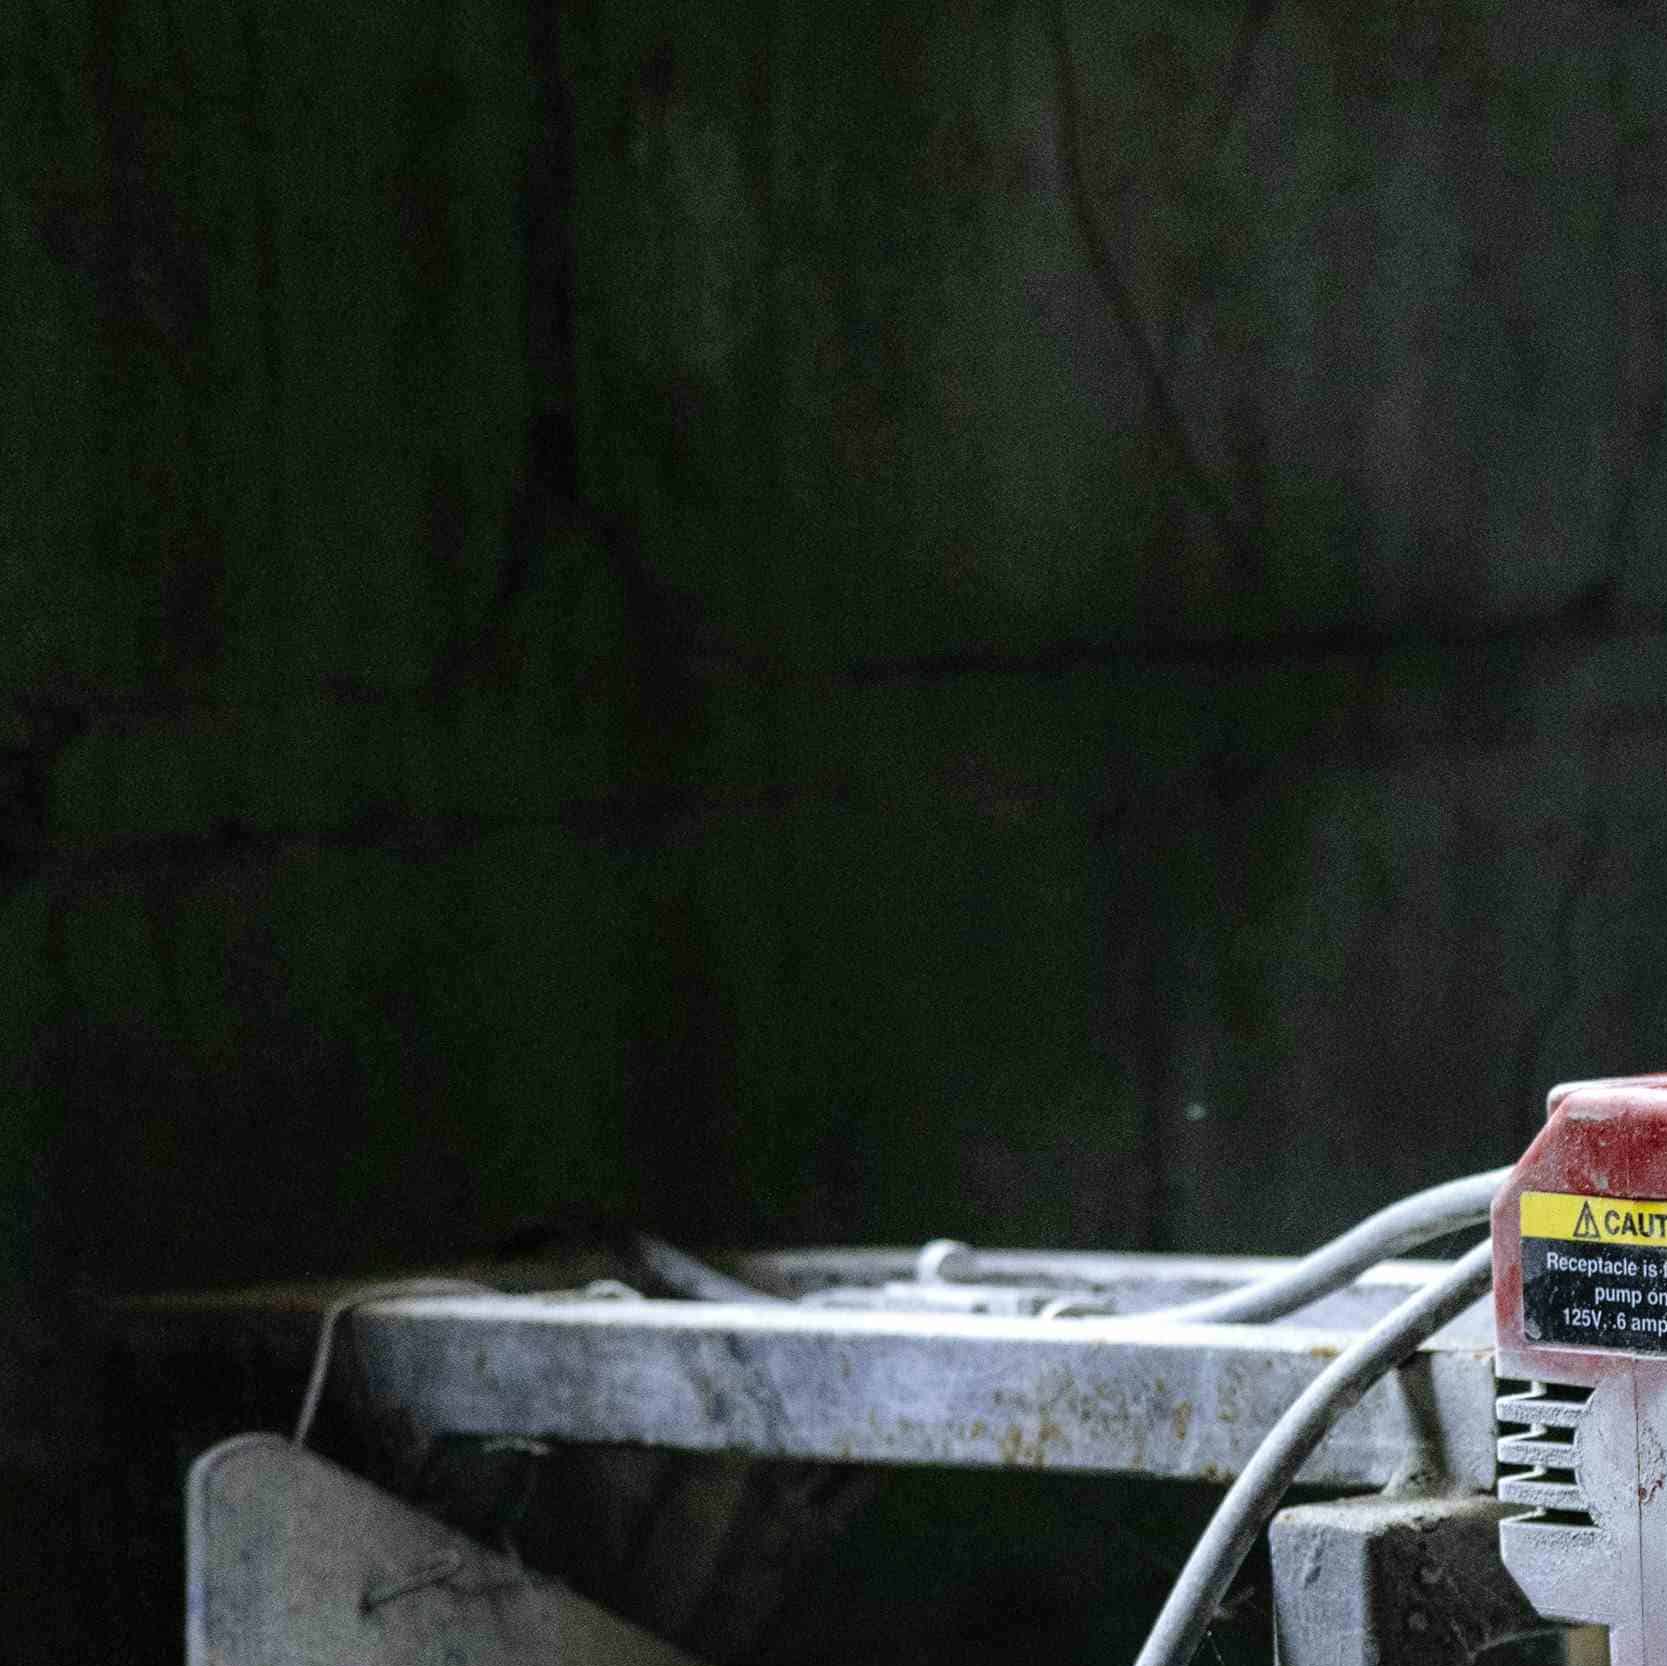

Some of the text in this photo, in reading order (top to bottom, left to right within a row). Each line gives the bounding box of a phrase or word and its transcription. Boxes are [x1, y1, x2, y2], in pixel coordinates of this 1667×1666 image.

[1546, 1252, 1638, 1277] Receptacle
[1643, 1259, 1658, 1278] is
[1594, 1287, 1642, 1307] pump
